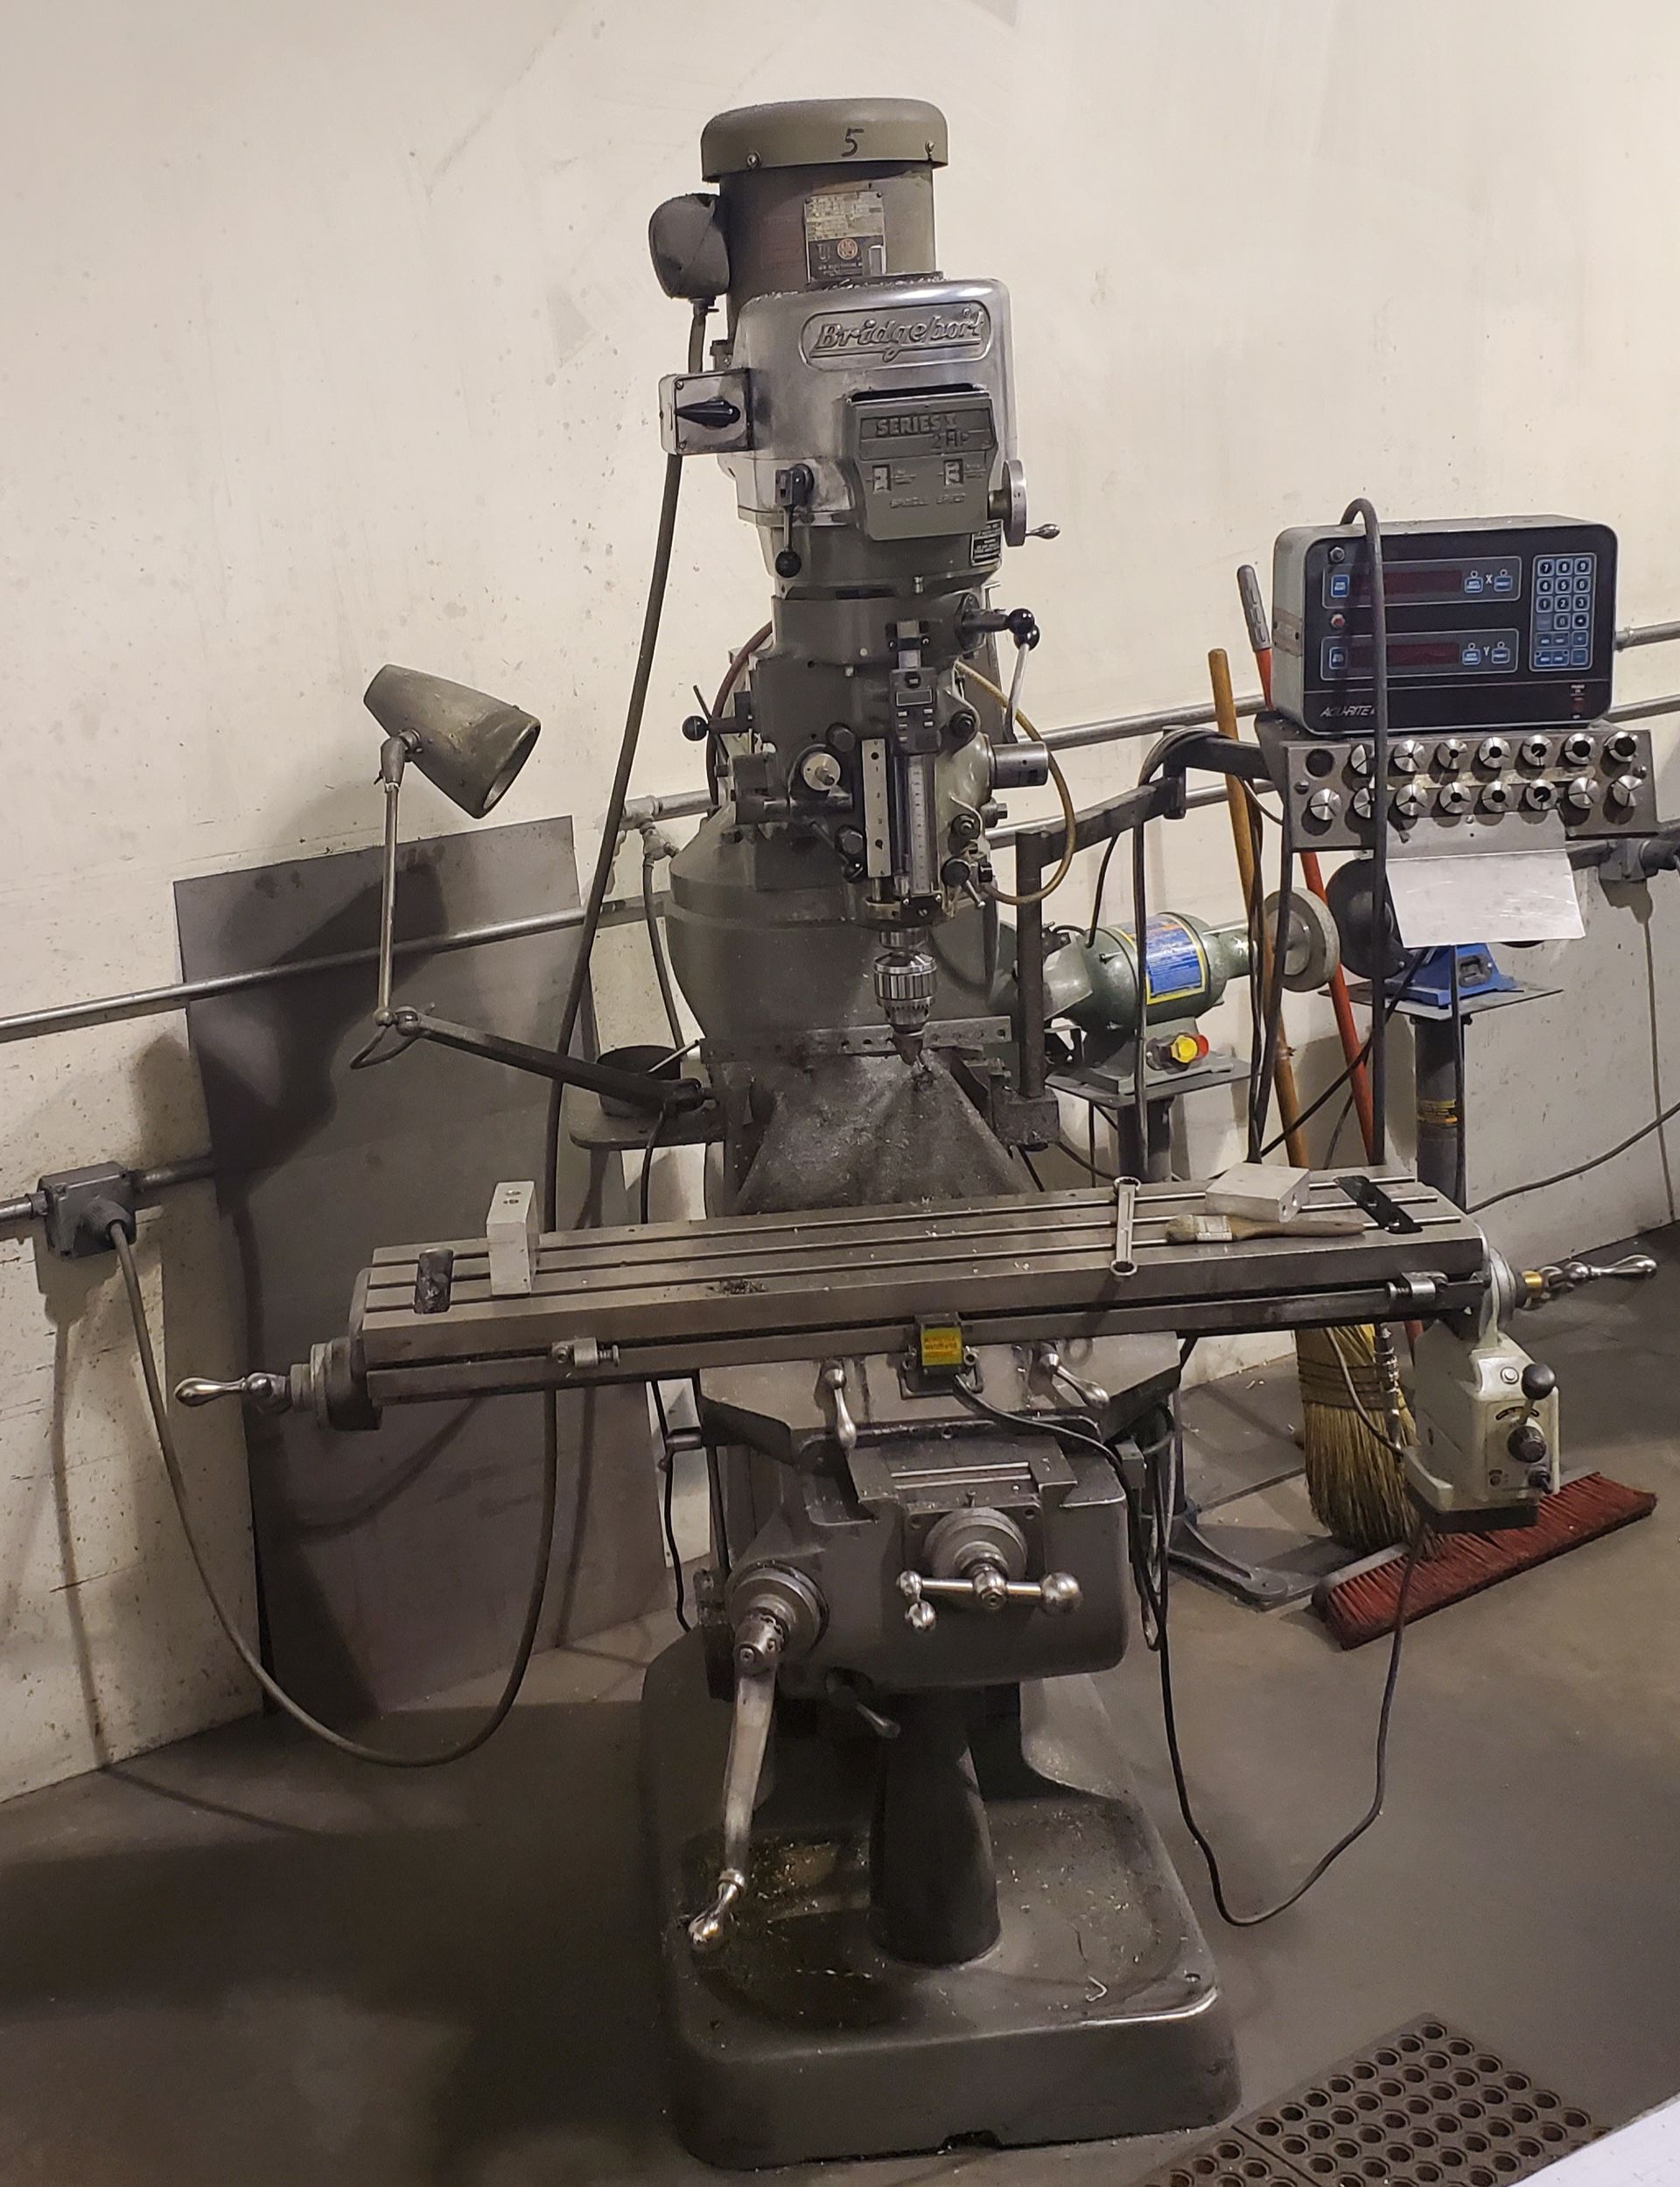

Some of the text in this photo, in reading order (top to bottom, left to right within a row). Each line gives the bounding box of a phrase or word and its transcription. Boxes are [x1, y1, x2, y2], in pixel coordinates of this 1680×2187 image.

[841, 128, 864, 158] 5
[814, 307, 984, 363] Bridgeport
[876, 414, 942, 436] SERIES
[1544, 563, 1550, 573] 7
[1579, 561, 1586, 571] 9
[1485, 574, 1493, 585] X
[1542, 581, 1549, 591] 4
[1560, 580, 1567, 590] 5
[1559, 599, 1566, 608] 2
[1578, 598, 1585, 607] 3
[1483, 646, 1490, 656] Y
